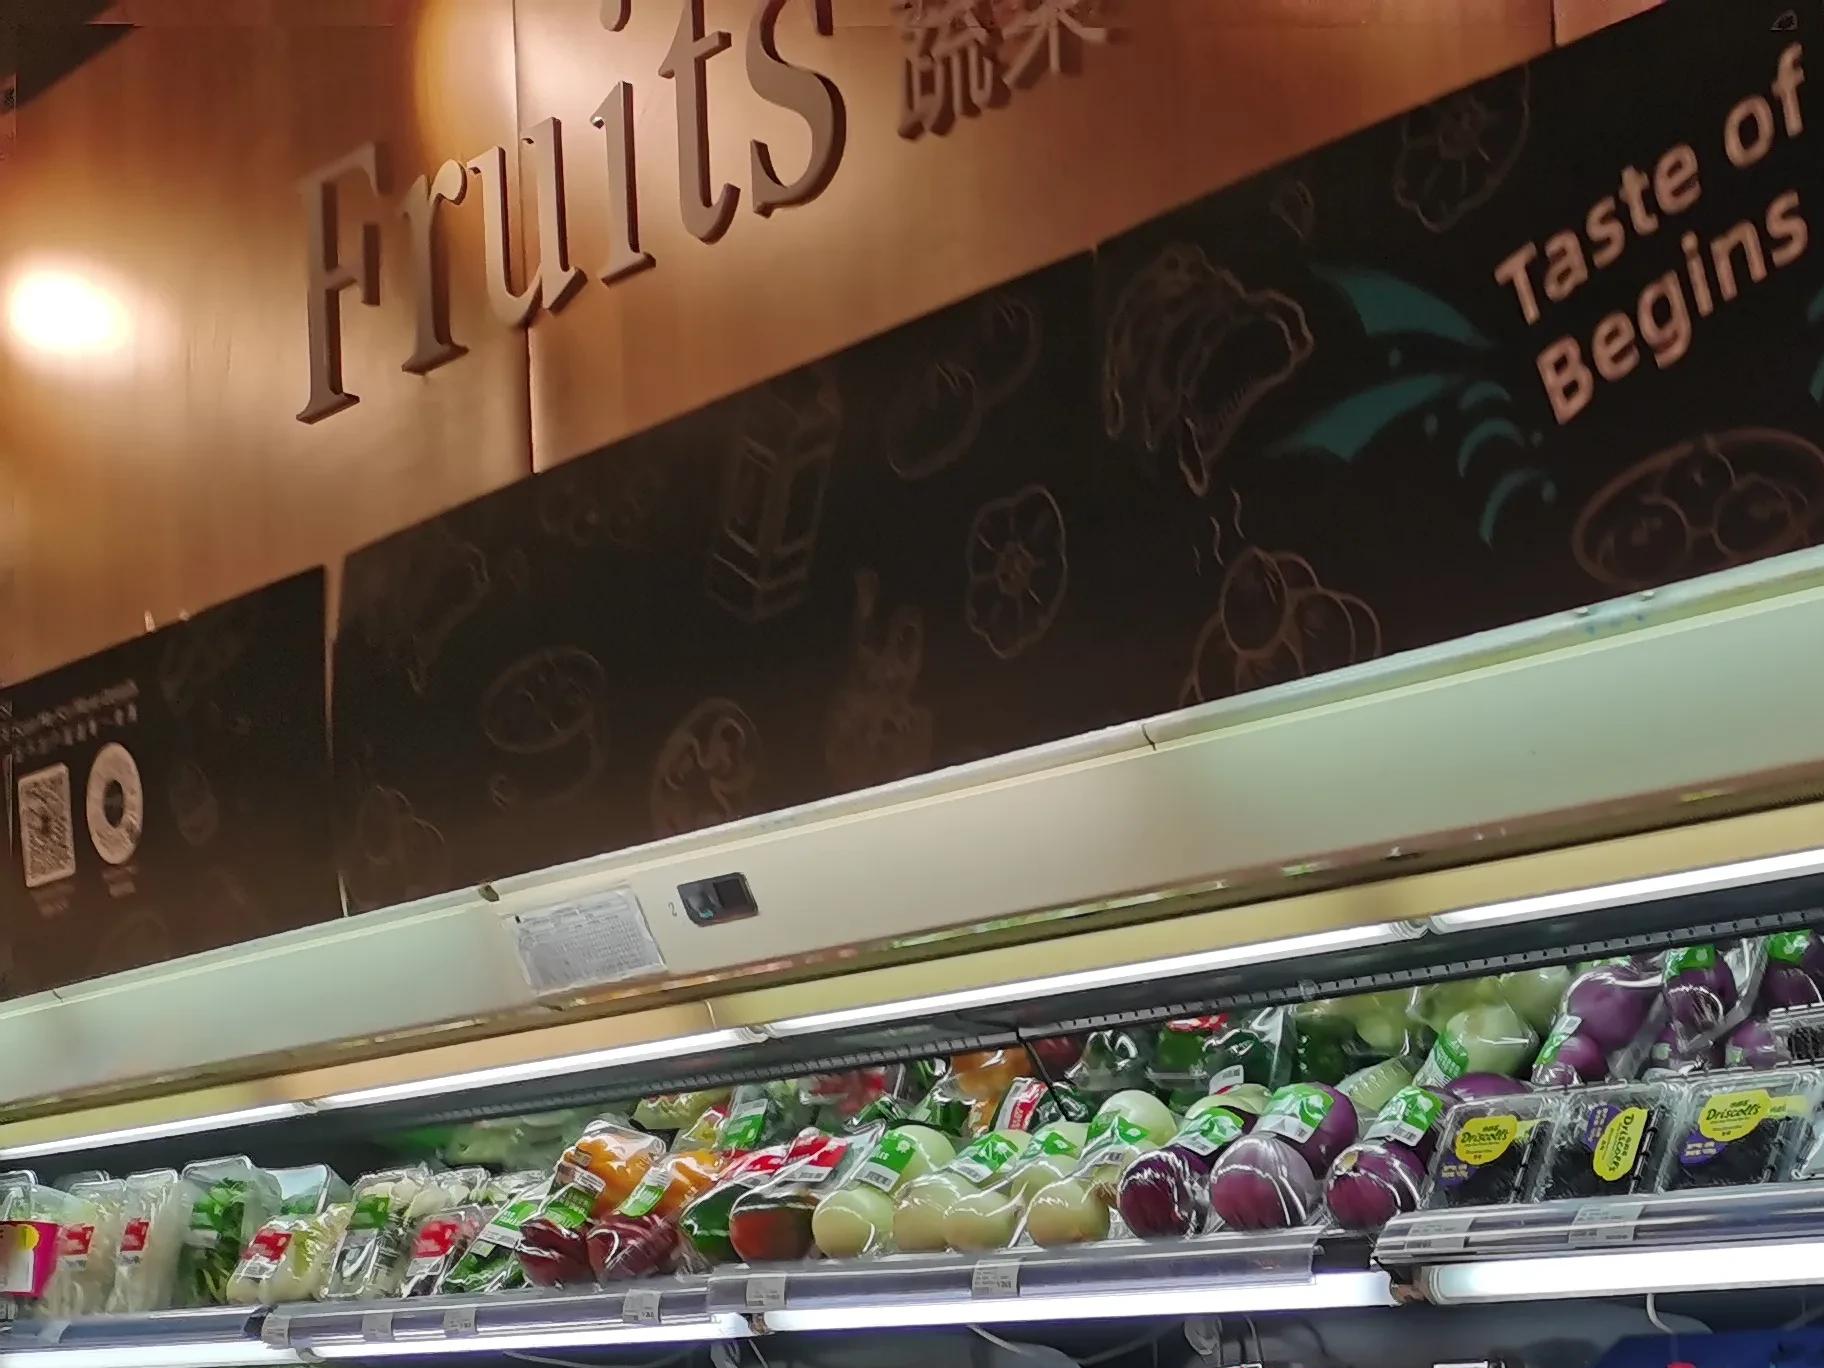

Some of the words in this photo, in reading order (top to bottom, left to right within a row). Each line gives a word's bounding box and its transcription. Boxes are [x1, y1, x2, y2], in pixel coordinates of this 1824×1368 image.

[296, 0, 847, 425] Fruits
[1494, 143, 1702, 325] Taste
[1723, 43, 1805, 168] of
[1536, 190, 1808, 425] Begins
[1705, 1102, 1762, 1121] Driscoll's
